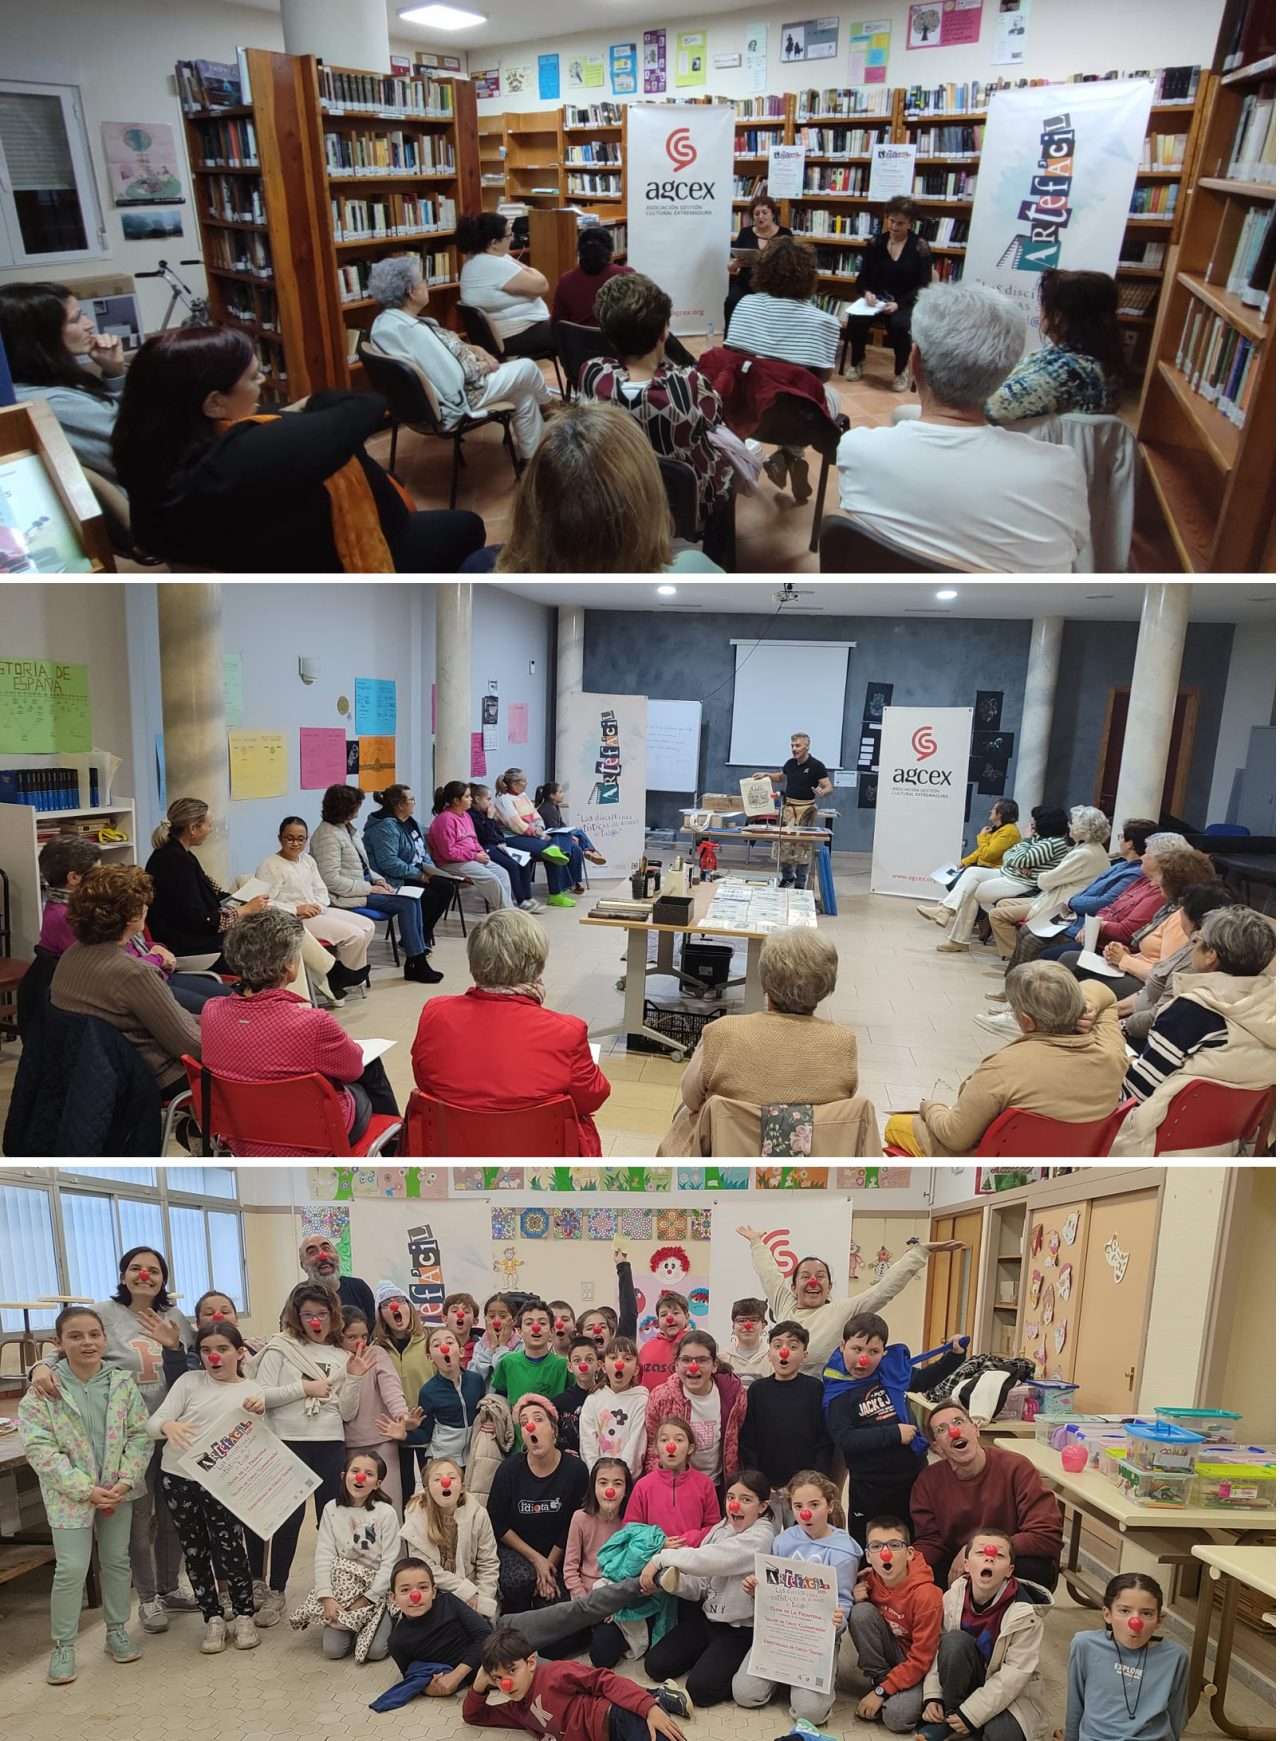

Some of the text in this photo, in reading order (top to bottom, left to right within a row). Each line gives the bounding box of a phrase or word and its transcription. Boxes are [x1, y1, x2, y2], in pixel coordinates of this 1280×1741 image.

[646, 180, 716, 202] agcex
[56, 665, 71, 681] DE
[893, 768, 952, 786] agcex
[859, 1398, 880, 1416] JACK
